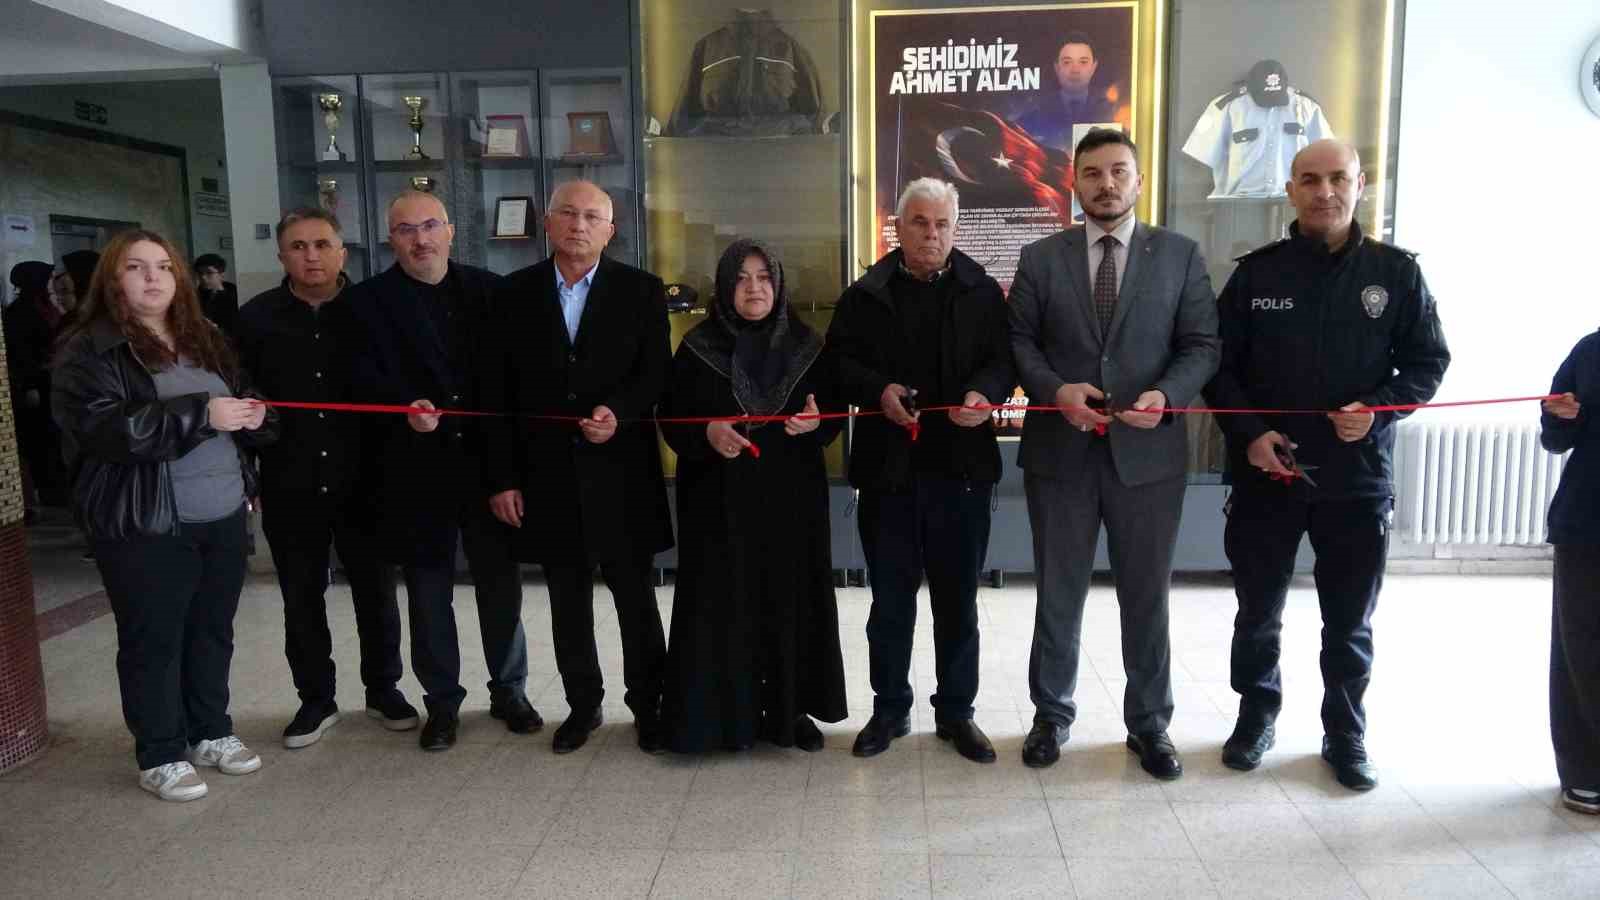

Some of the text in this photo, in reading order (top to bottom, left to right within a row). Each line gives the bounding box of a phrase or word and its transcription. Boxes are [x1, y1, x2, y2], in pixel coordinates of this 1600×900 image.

[902, 37, 1019, 77] ŞEHİDİMİZ
[889, 67, 1041, 95] AHMET ALAN
